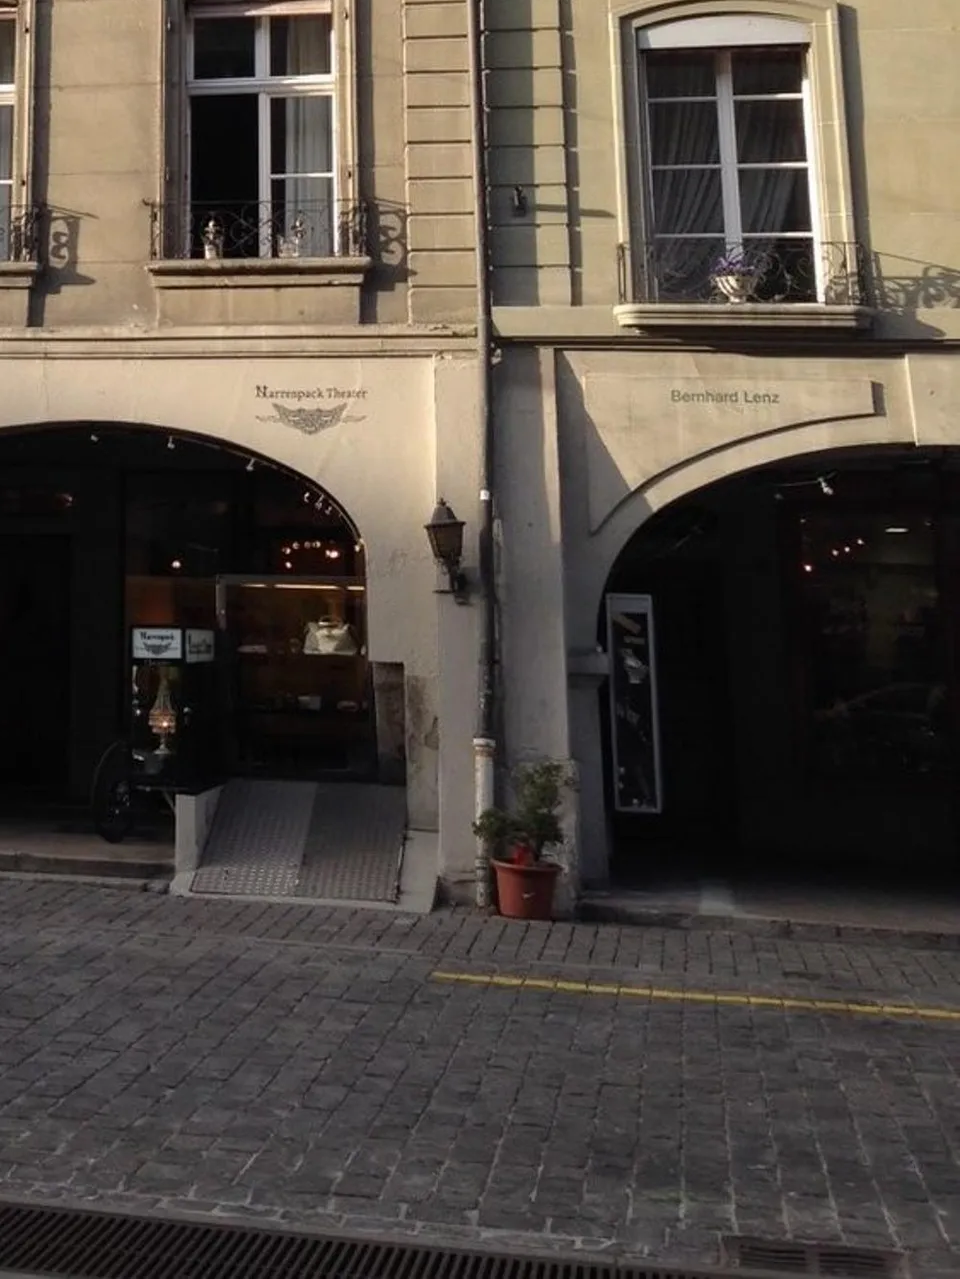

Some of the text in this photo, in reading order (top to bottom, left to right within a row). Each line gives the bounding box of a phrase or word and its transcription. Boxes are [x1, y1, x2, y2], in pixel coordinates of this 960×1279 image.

[255, 384, 368, 401] Narrenpack Theater
[671, 389, 780, 404] Bernhard Lenz
